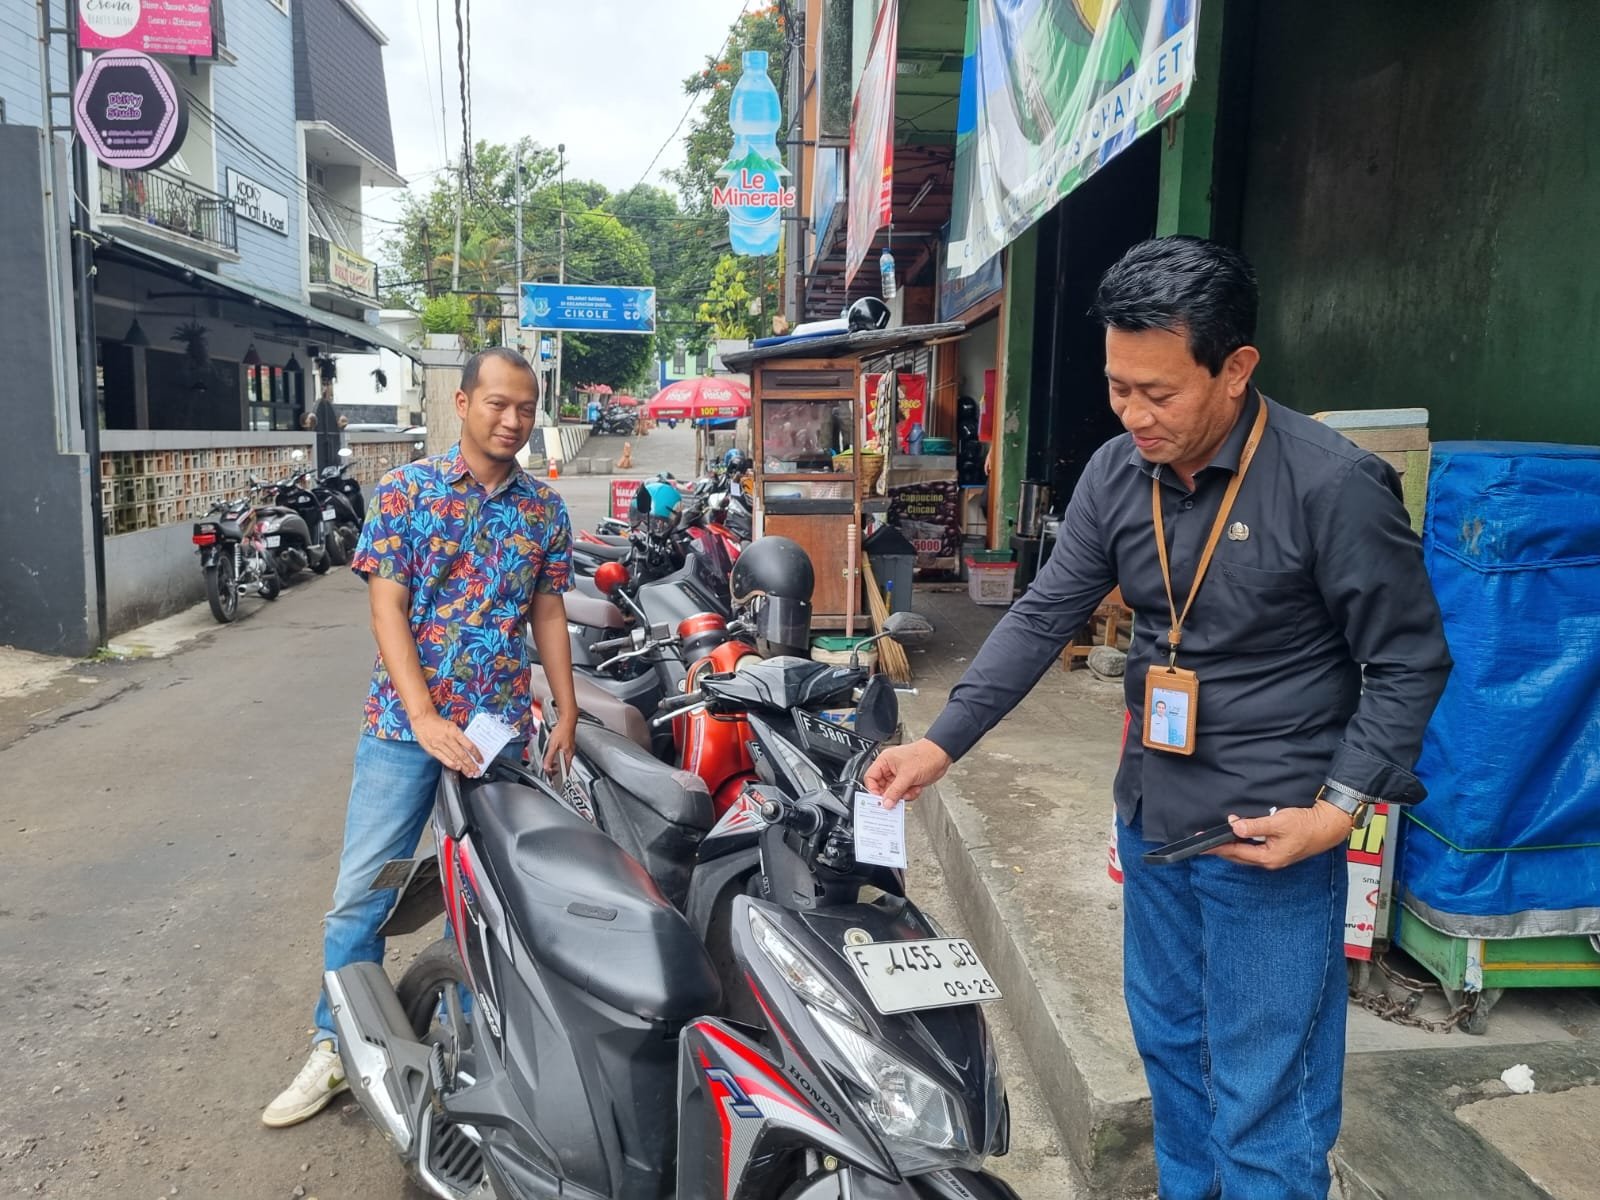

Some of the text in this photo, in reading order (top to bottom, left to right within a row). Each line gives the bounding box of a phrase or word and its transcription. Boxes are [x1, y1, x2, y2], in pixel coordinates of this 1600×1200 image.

[742, 169, 765, 190] Le
[712, 187, 795, 207] Minerale
[564, 309, 609, 319] CIKOLE
[907, 505, 936, 514] Cincau
[802, 716, 812, 731] F
[818, 723, 852, 748] 5807
[853, 942, 978, 977] F 4455 SB
[789, 1064, 841, 1126] HONDA
